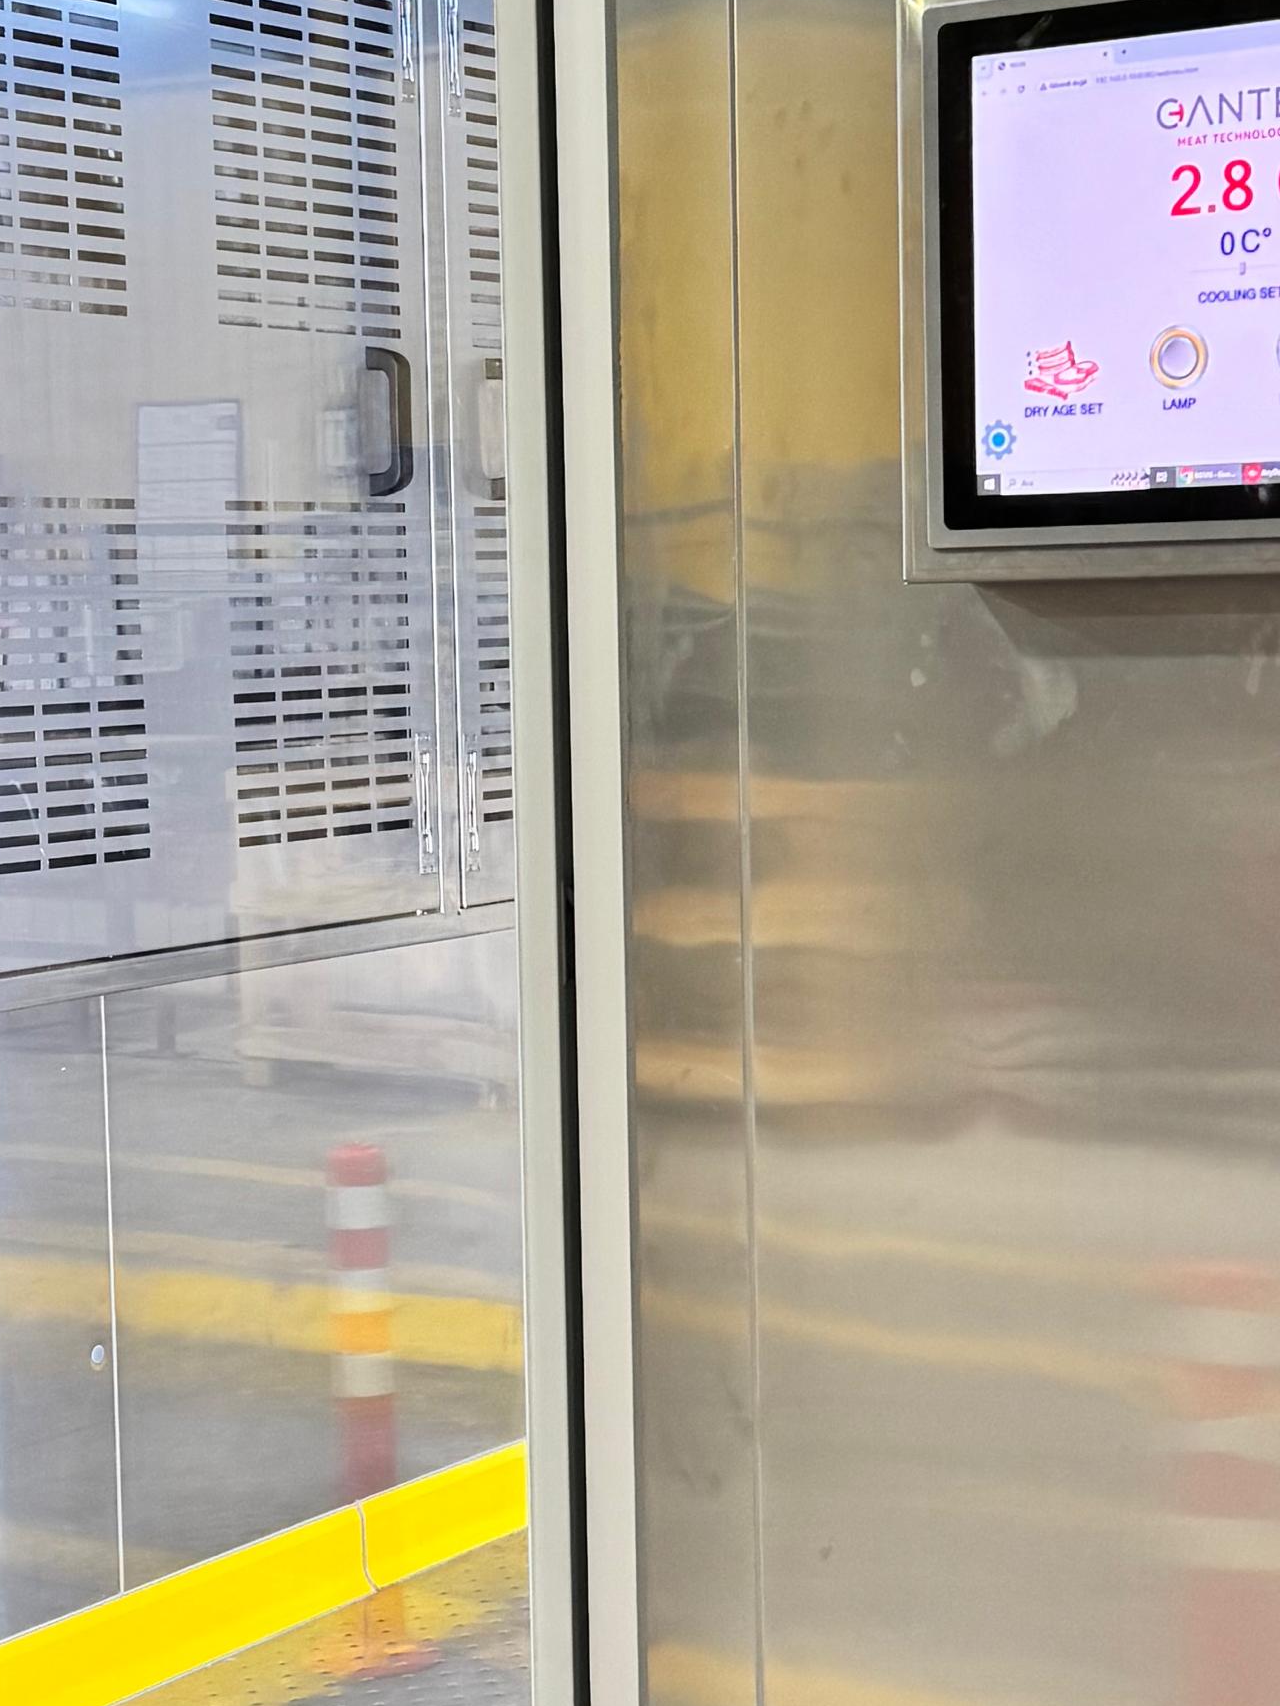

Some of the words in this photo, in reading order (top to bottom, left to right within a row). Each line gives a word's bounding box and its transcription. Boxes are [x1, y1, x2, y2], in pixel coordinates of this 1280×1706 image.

[1177, 134, 1208, 147] MEAT
[1170, 159, 1254, 216] 2.8
[1220, 231, 1235, 256] 0
[1198, 288, 1256, 304] COOLING
[1024, 405, 1051, 418] DRY
[1053, 404, 1078, 417] AGE
[1080, 402, 1104, 416] SET
[1162, 397, 1196, 411] LAMP
